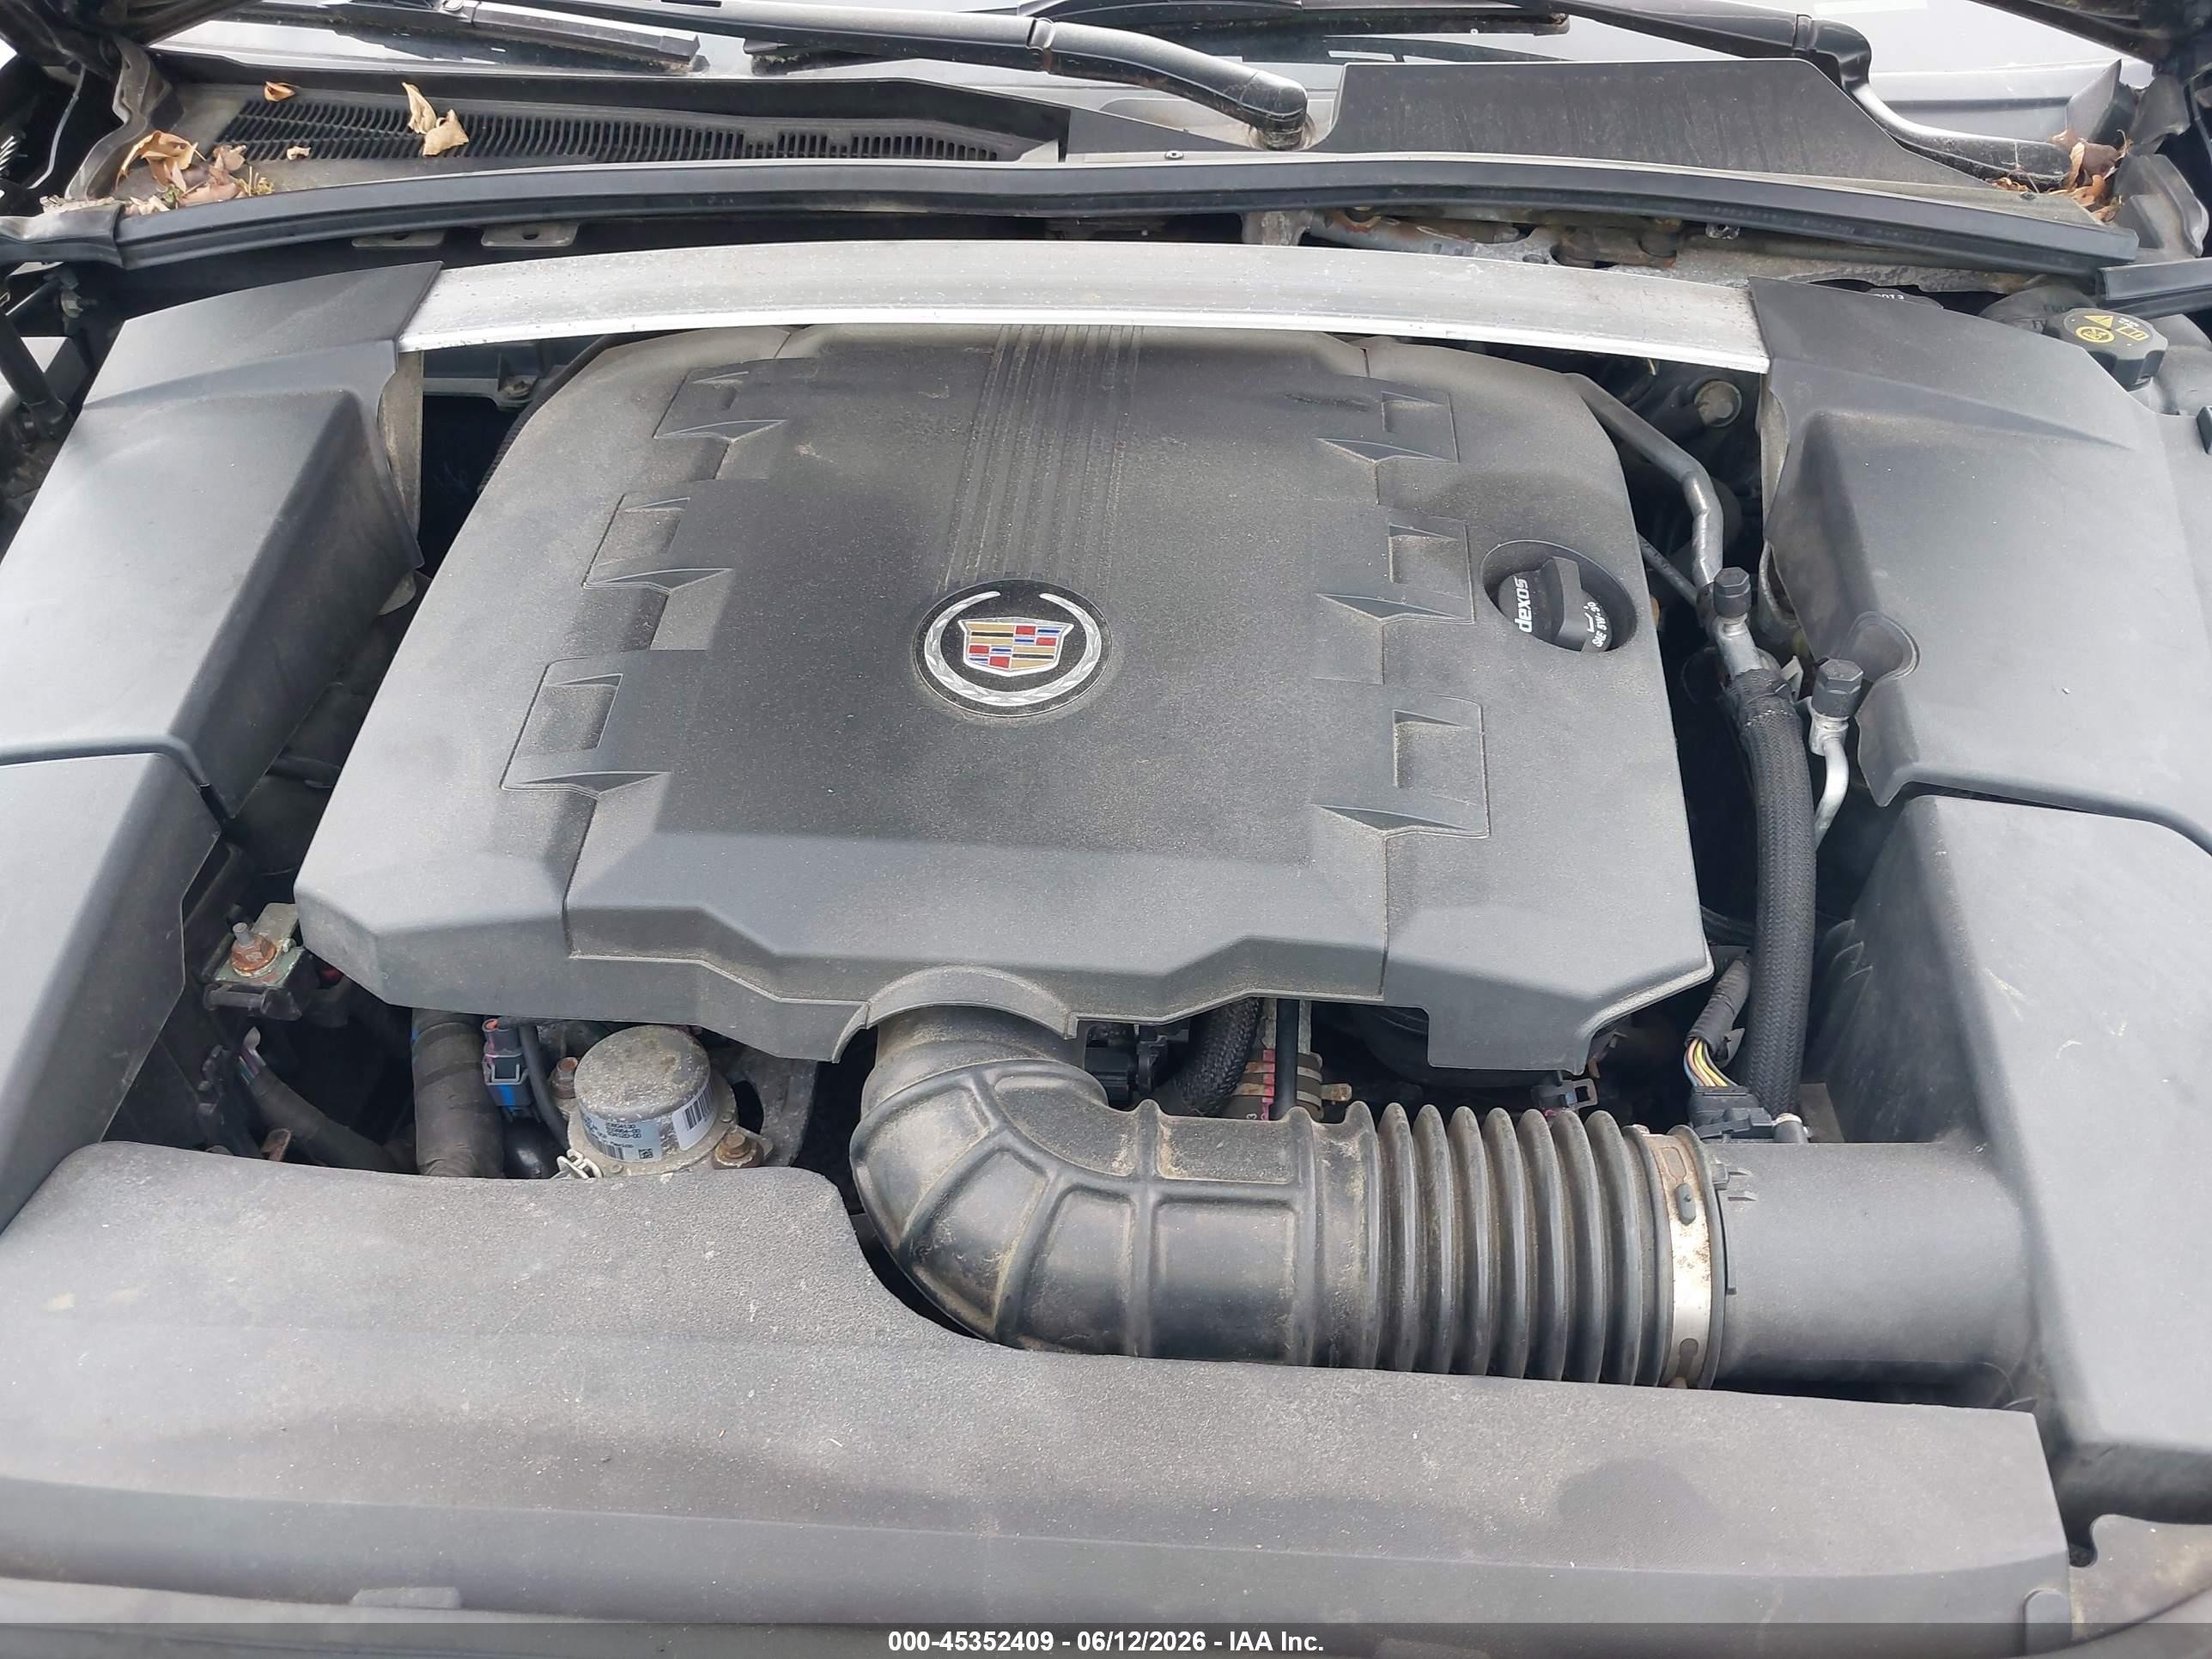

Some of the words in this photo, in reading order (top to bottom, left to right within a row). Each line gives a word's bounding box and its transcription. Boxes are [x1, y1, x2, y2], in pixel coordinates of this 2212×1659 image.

[1513, 575, 1533, 633] dexos
[1587, 601, 1607, 631] 5W-30
[1591, 630, 1607, 647] SAE
